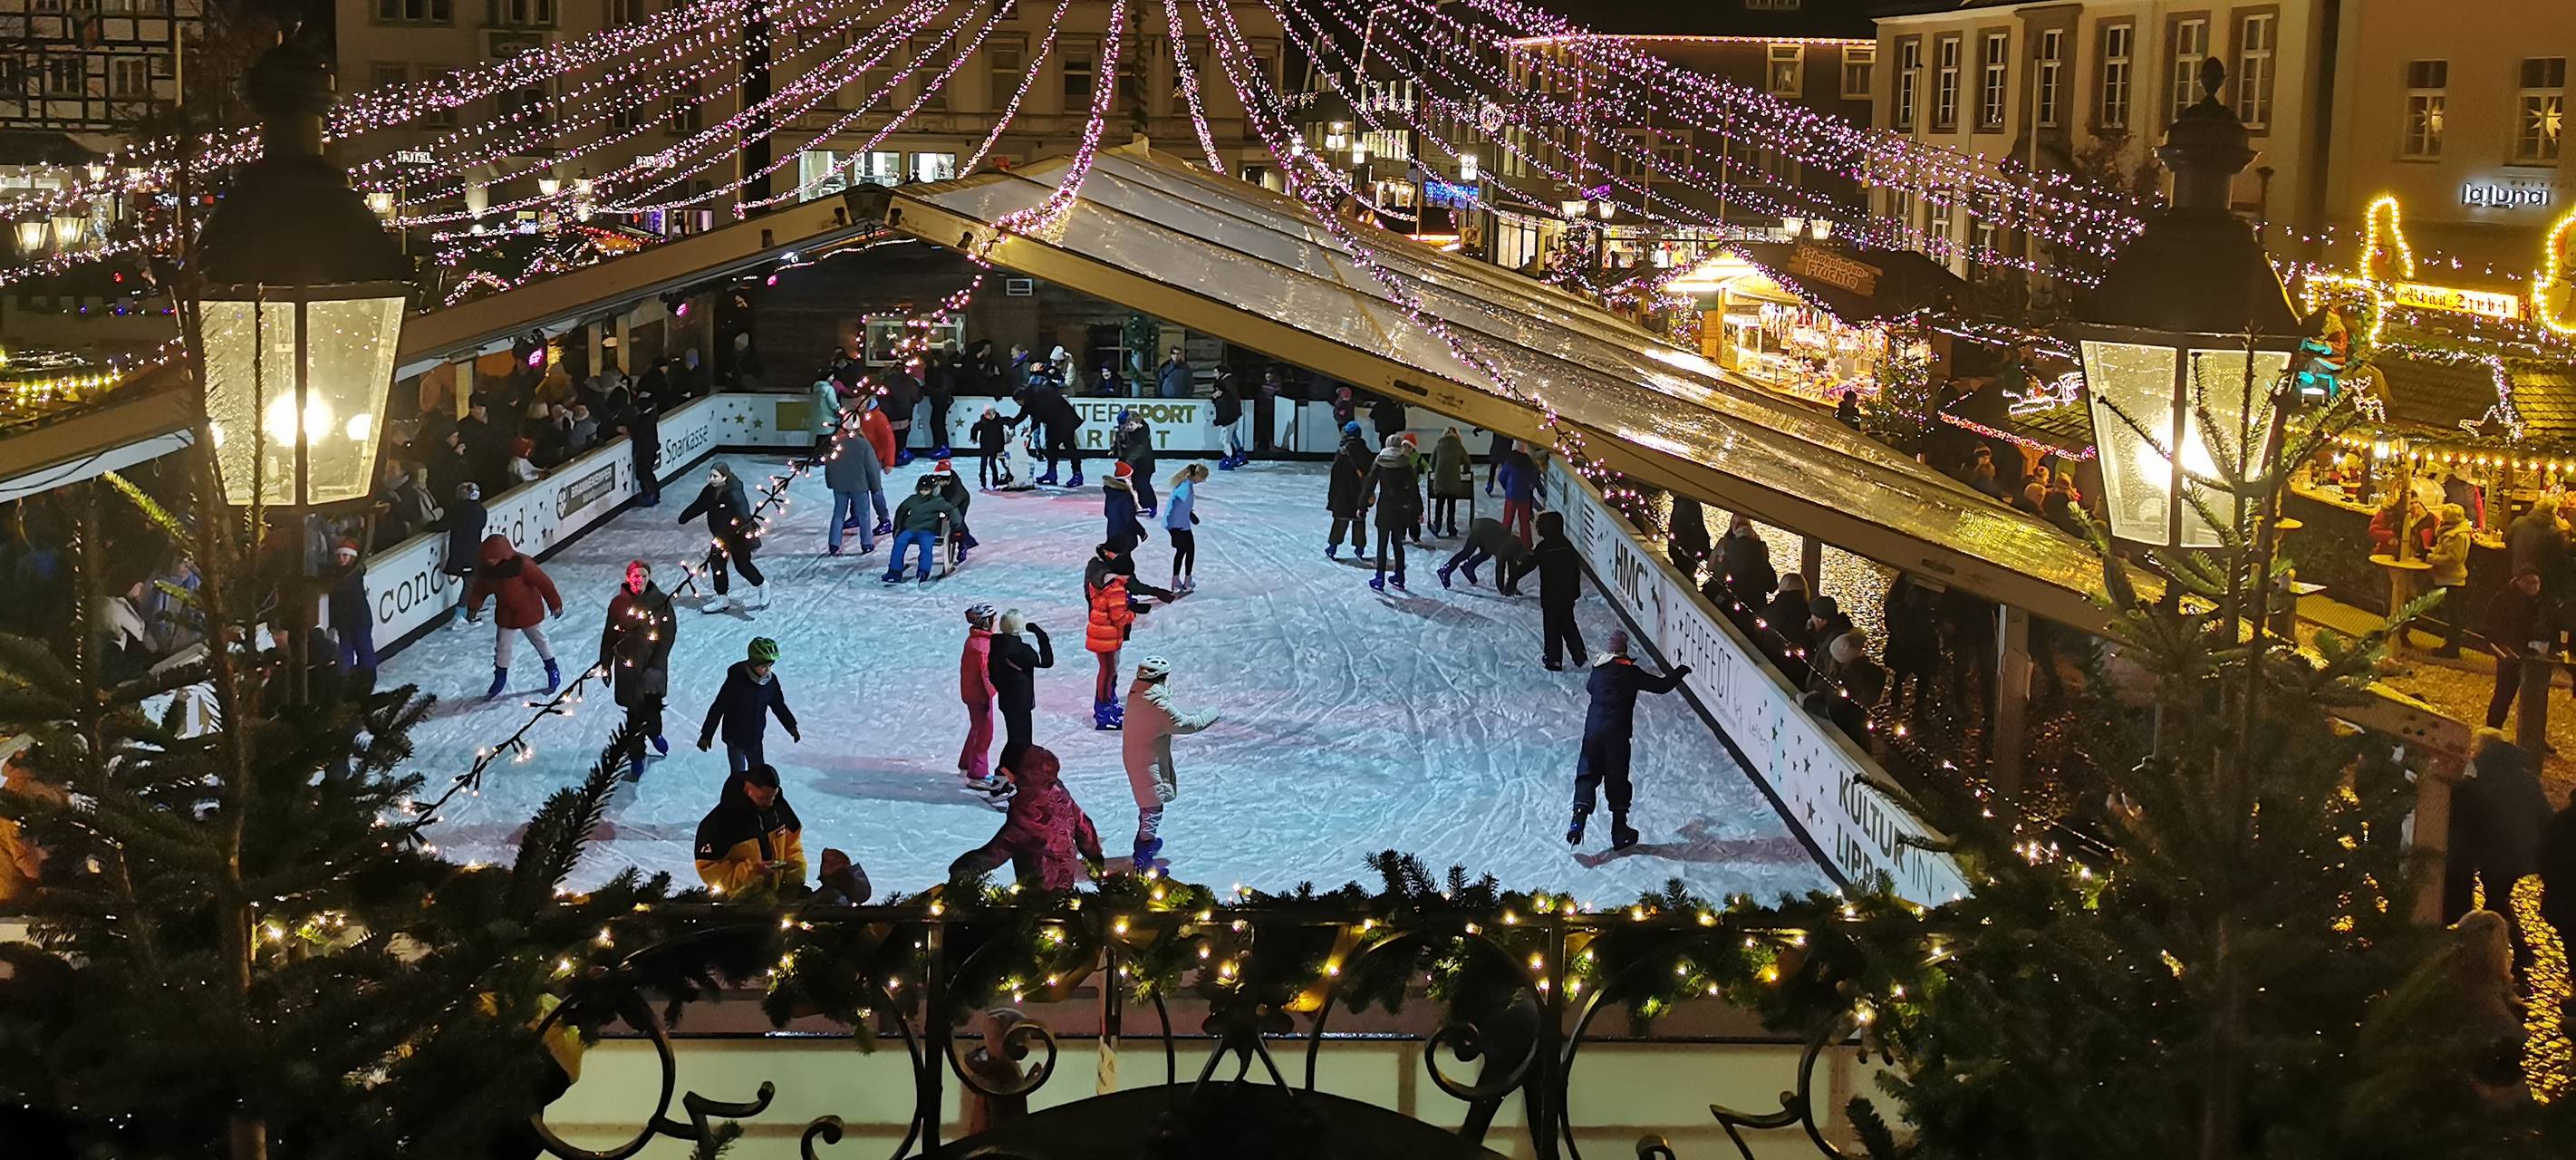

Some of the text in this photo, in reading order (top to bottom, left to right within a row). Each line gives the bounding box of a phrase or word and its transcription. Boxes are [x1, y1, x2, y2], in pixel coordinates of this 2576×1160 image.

[666, 425, 709, 467] Sparkasse
[1073, 403, 1196, 423] TERPORT
[1615, 537, 1644, 612] HMC
[1684, 612, 1732, 706] PERFECT
[1836, 823, 1874, 884] LIPP
[1838, 770, 1933, 904] KULTUR IN
